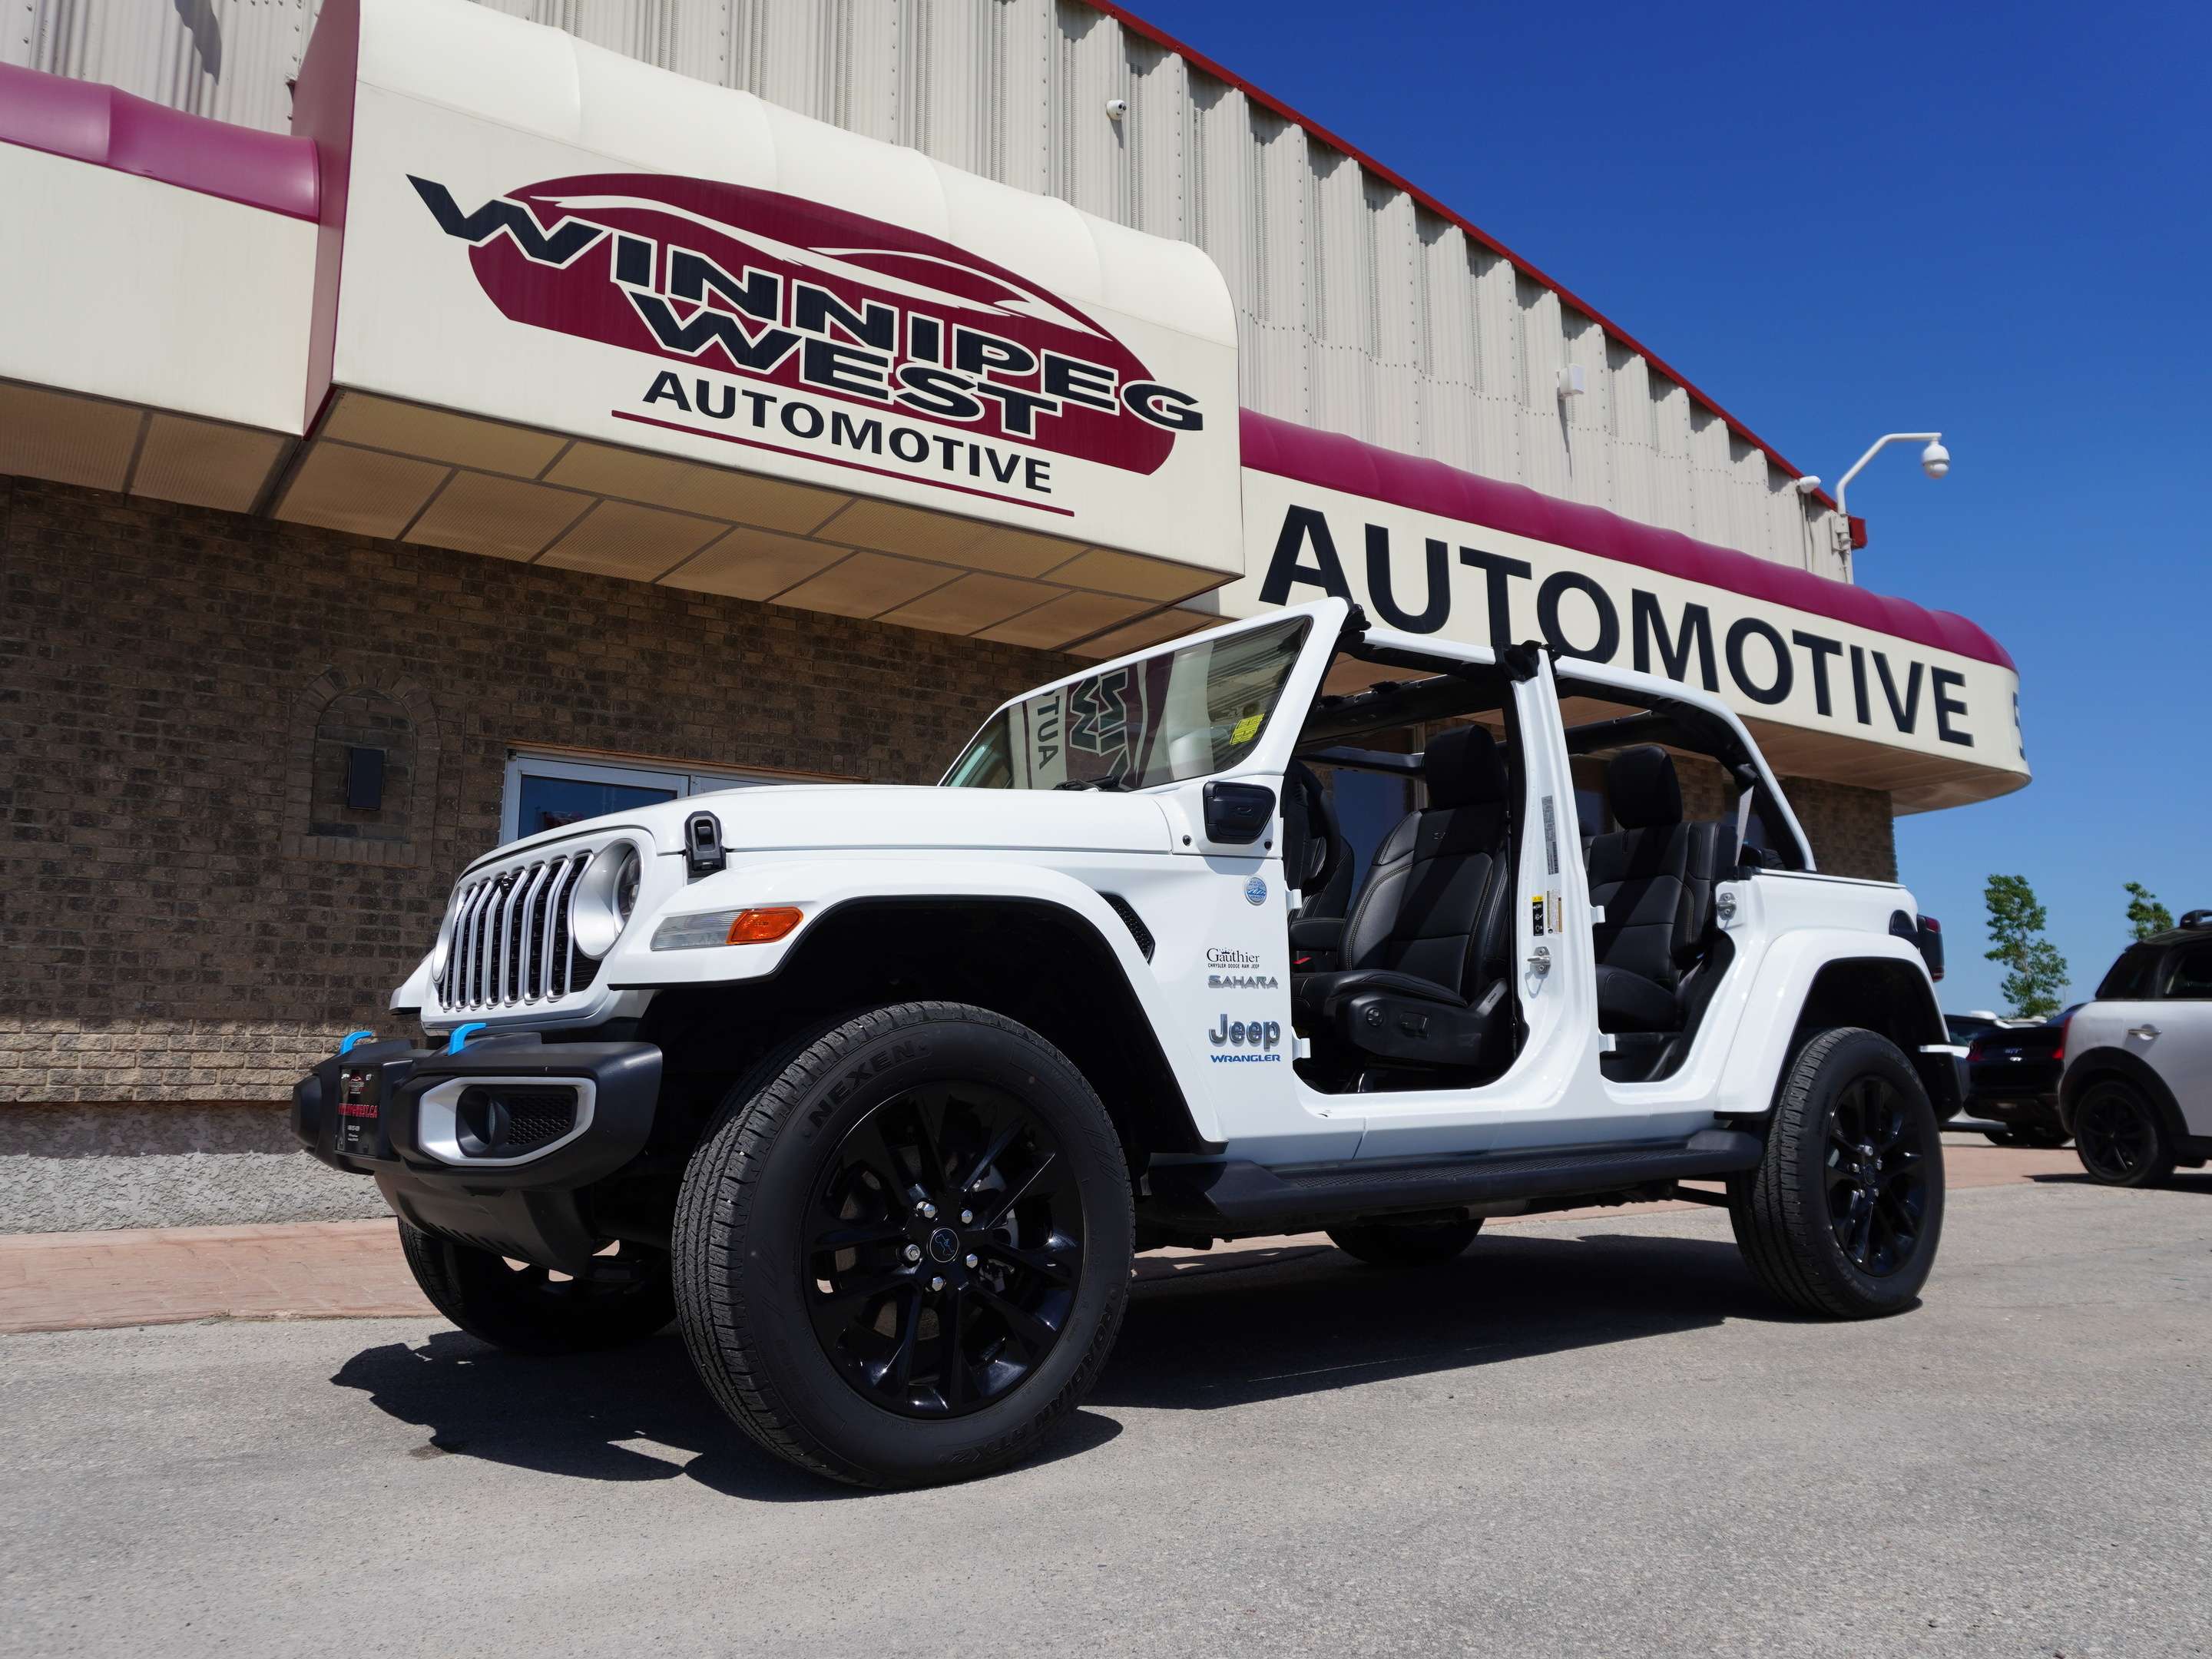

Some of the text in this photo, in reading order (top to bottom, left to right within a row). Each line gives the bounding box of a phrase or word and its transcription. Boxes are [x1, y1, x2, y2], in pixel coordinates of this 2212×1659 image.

[406, 174, 1204, 432] WINNIPEG
[629, 290, 1059, 439] WEST
[643, 371, 1052, 494] AUTOMOTIVE
[1259, 504, 1975, 747] AUTOMOTIVE
[1207, 948, 1260, 962] Gauthier
[1208, 975, 1278, 988] SAHARA
[1208, 1013, 1280, 1051] Jeep
[1210, 1055, 1281, 1063] WRANGLER
[809, 1040, 915, 1128] NEXEN
